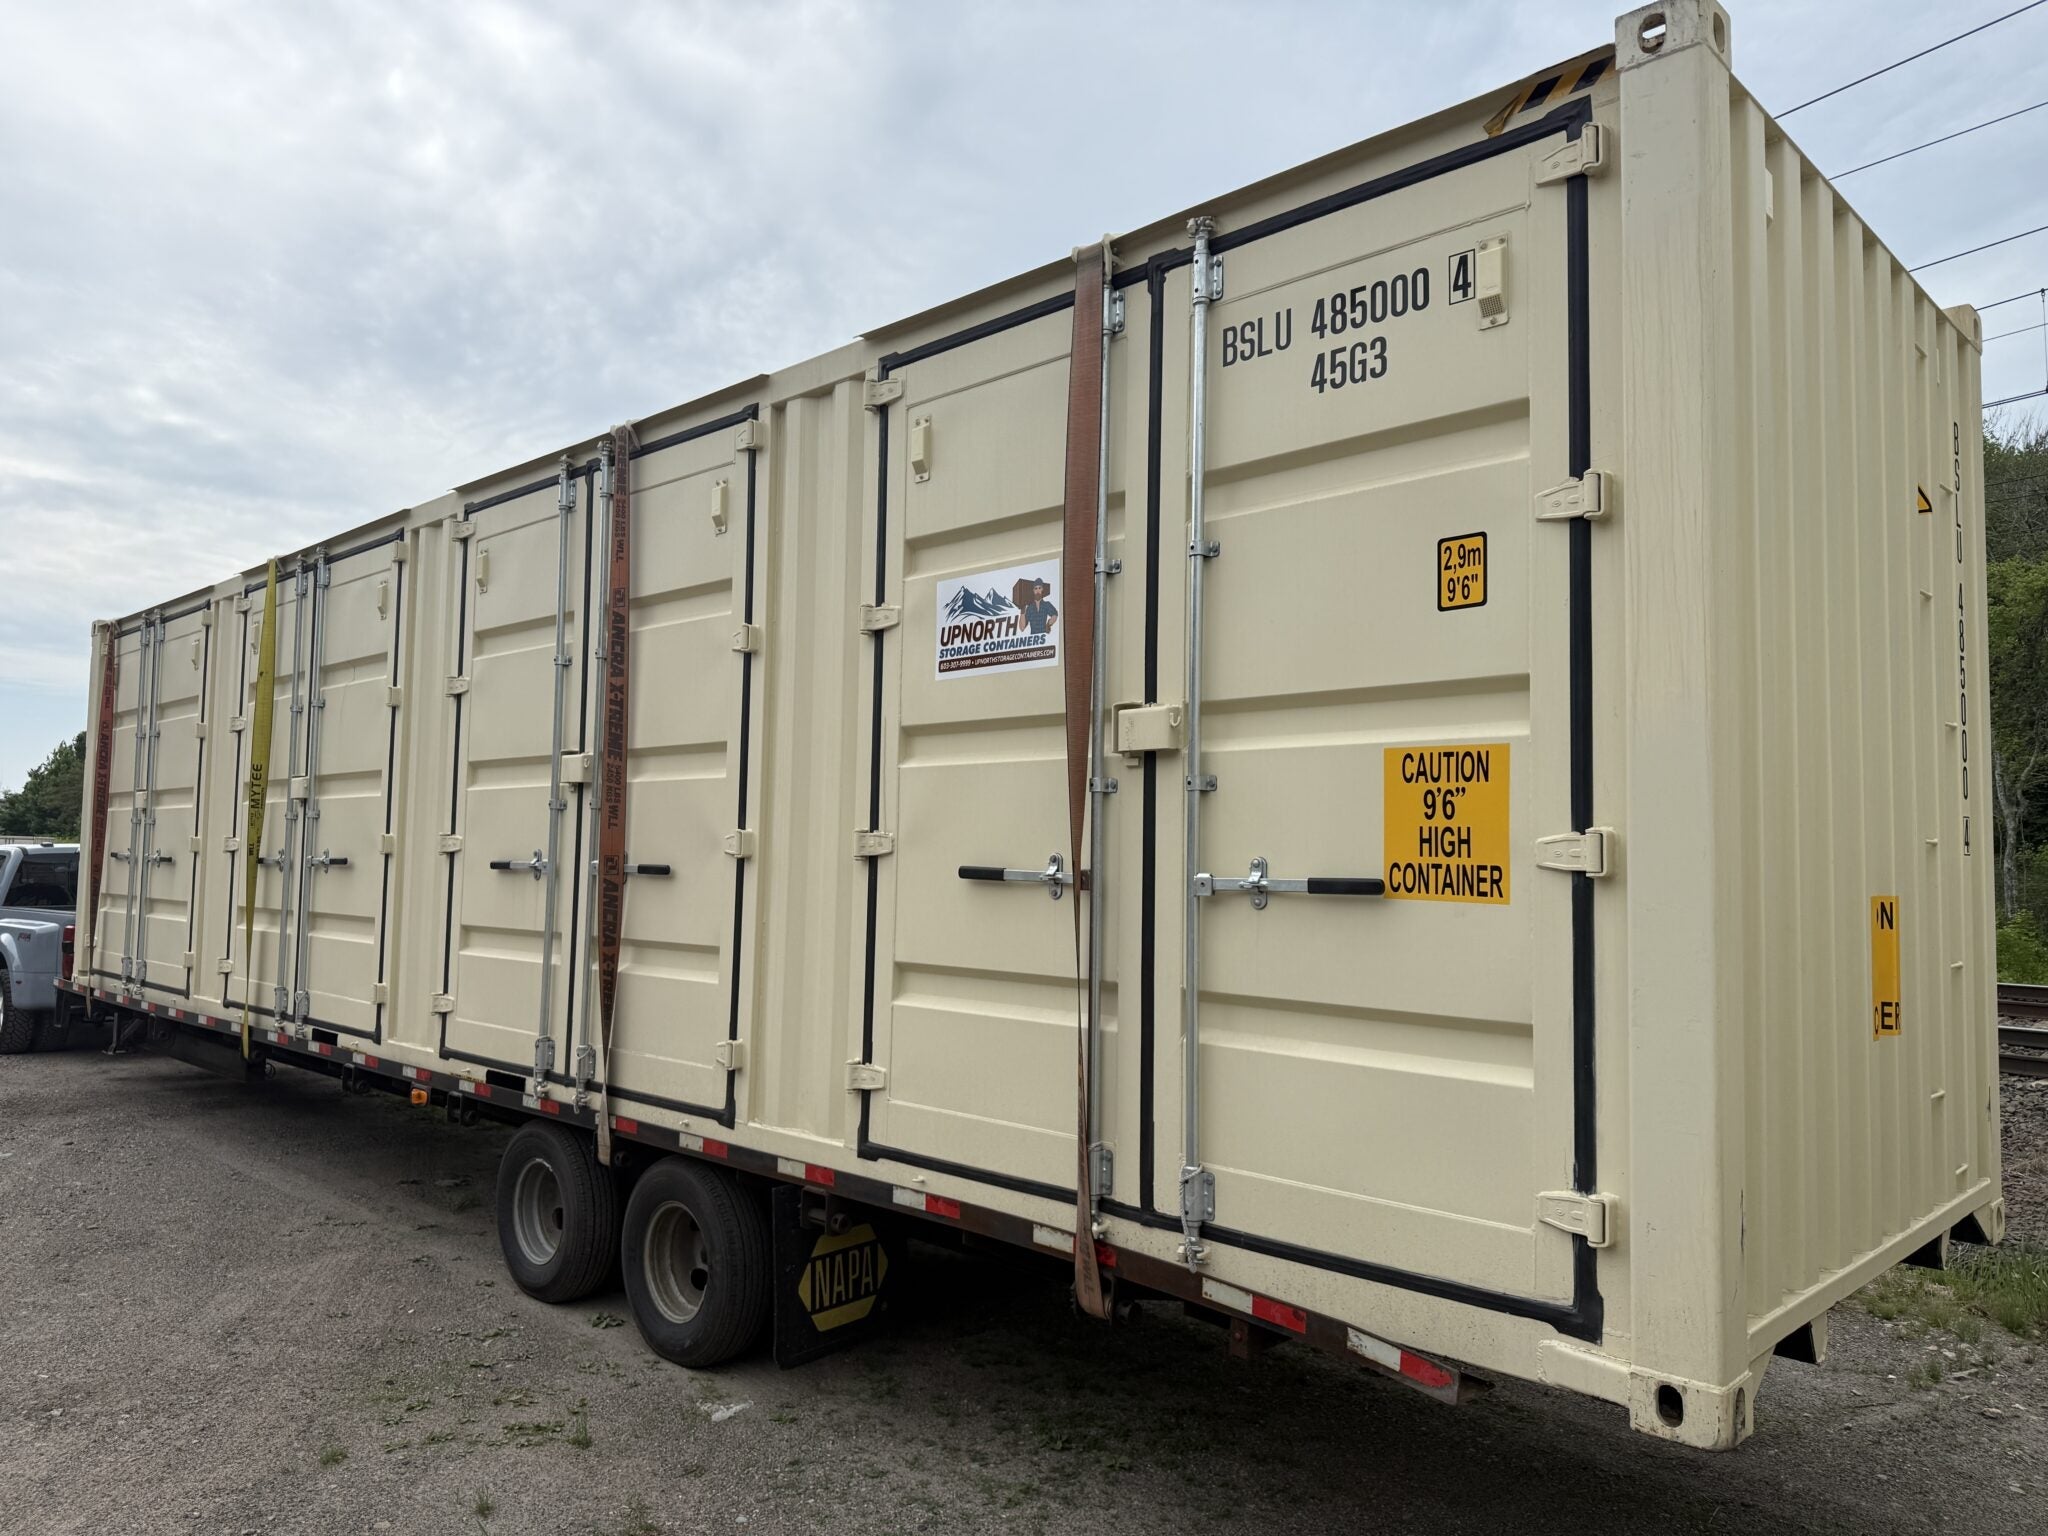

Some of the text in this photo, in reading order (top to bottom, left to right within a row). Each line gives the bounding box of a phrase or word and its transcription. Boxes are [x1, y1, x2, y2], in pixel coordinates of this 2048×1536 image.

[1222, 252, 1473, 368] BSLU 485000 4
[1310, 336, 1388, 394] 45G3
[1953, 421, 1963, 564] BSLU
[1443, 543, 1482, 573] 2,9m
[1447, 574, 1478, 602] 9'6"
[610, 611, 626, 678] ANCRA
[939, 634, 1047, 659] STORAGE CONTAINERS
[940, 614, 1020, 647] UPNORTH
[1957, 582, 1969, 800] 485000
[607, 682, 625, 762] X-TREME
[250, 763, 263, 809] MYTEE
[1402, 750, 1490, 784] CAUTION
[1419, 825, 1472, 859] HIGH
[1389, 862, 1504, 899] CONTAINER
[602, 878, 619, 946] ANCRA
[815, 1246, 874, 1310] NAPA
